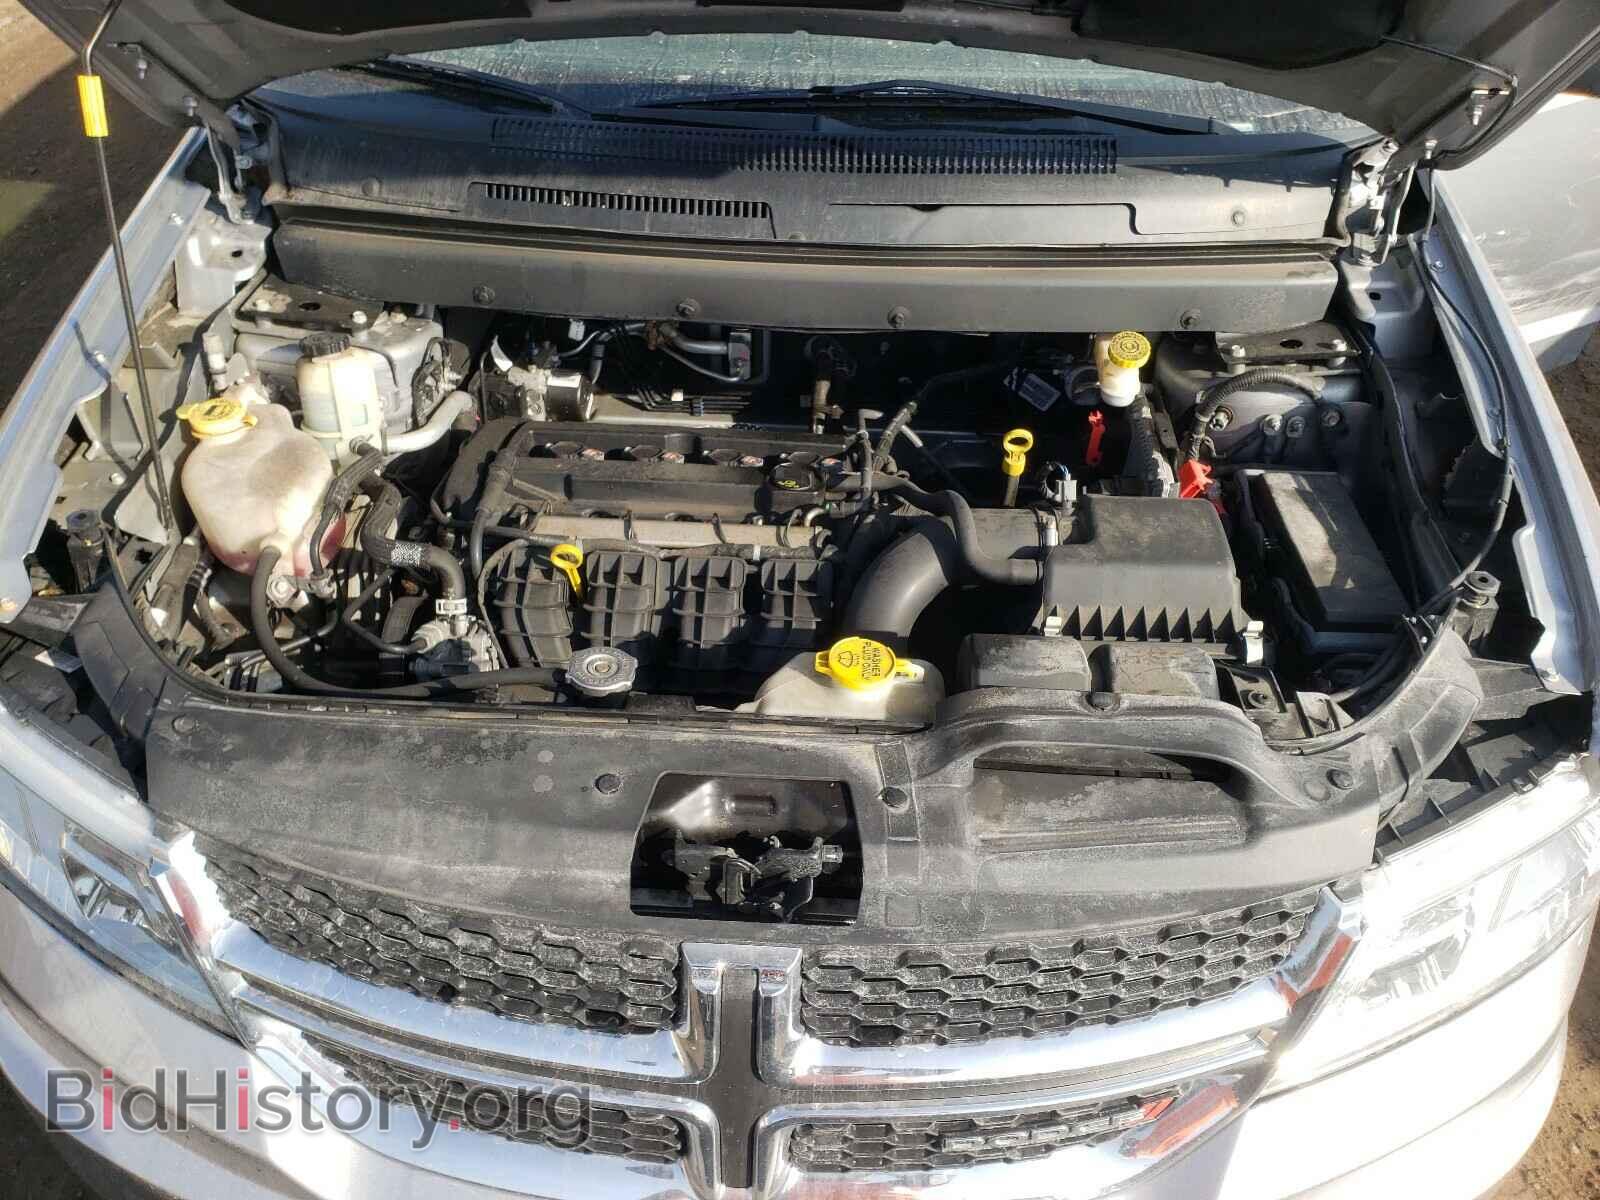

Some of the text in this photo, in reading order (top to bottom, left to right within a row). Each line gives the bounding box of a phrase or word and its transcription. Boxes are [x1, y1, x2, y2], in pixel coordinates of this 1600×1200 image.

[862, 641, 871, 681] FLUID ONLY
[871, 647, 880, 676] WASHER
